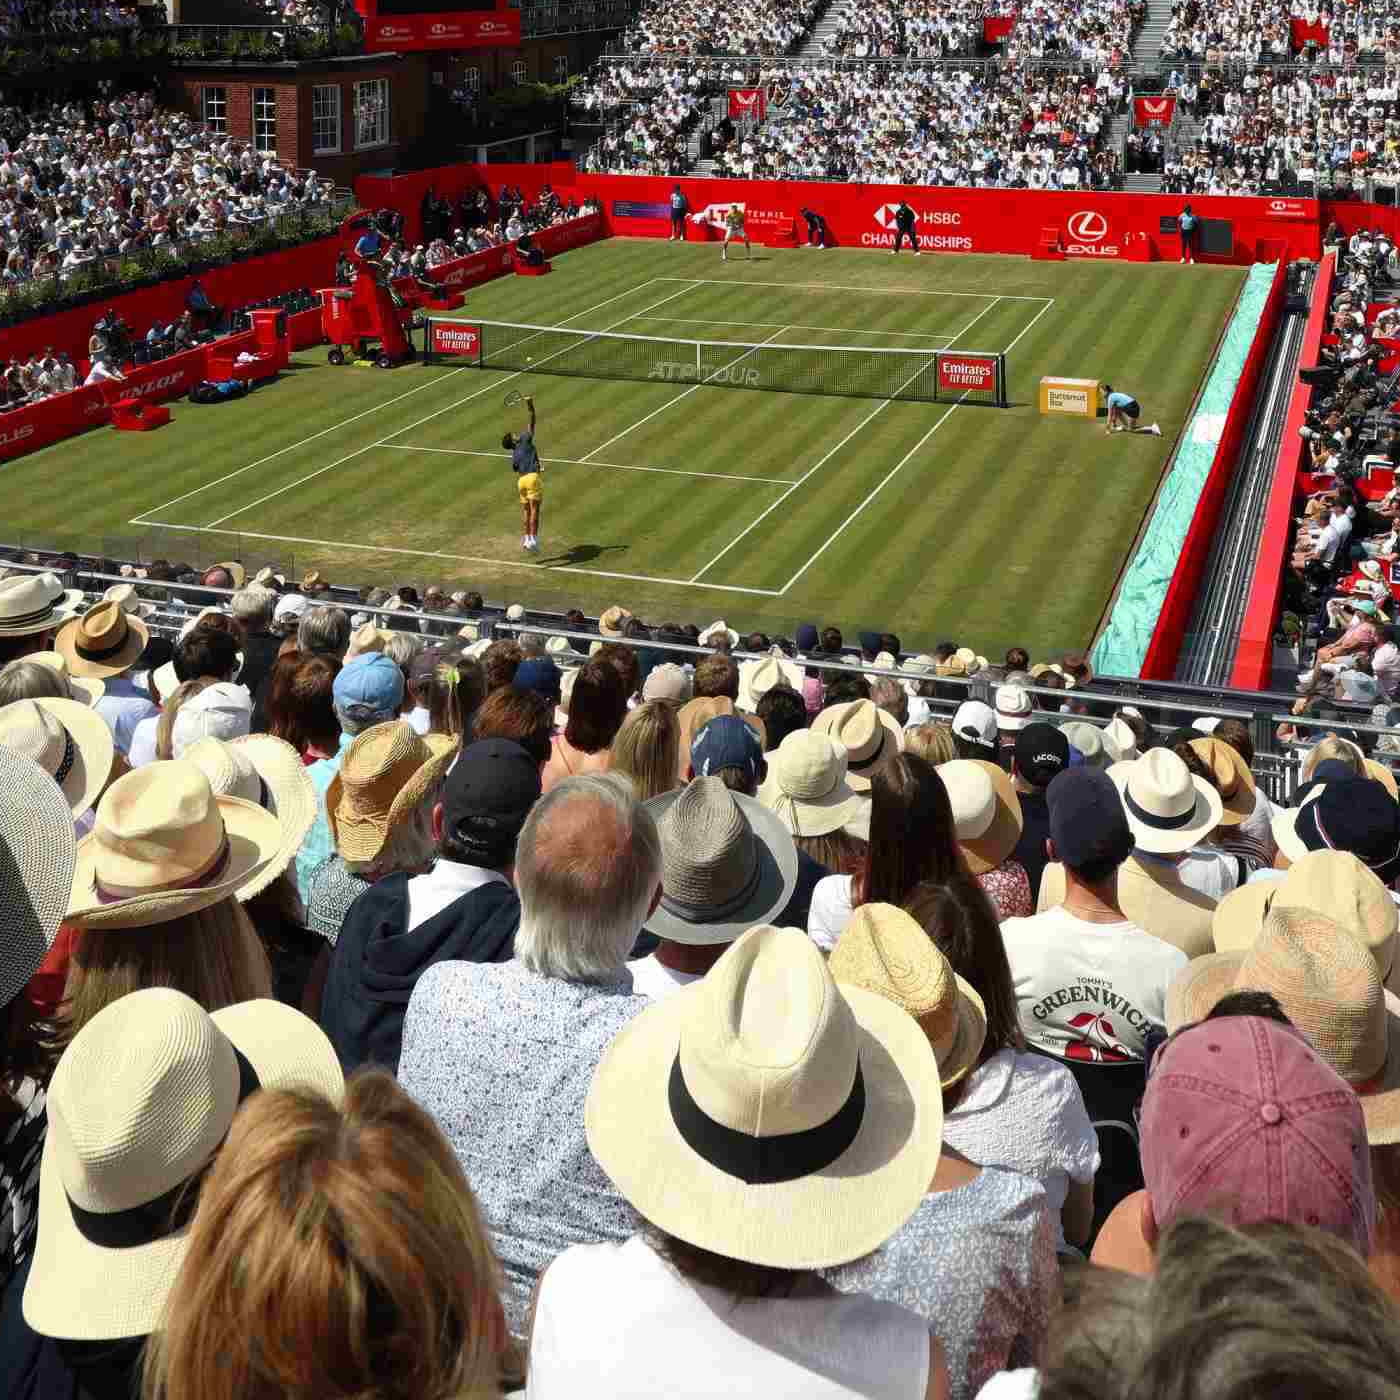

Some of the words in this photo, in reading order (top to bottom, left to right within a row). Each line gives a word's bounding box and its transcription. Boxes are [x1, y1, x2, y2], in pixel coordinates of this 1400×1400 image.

[923, 211, 961, 225] HSBC
[861, 232, 973, 249] CHAMPONSHIPS
[1057, 244, 1119, 255] LEXUS
[436, 329, 476, 341] Emirates
[943, 362, 991, 376] Emirates
[1076, 976, 1113, 989] TOMMY'S
